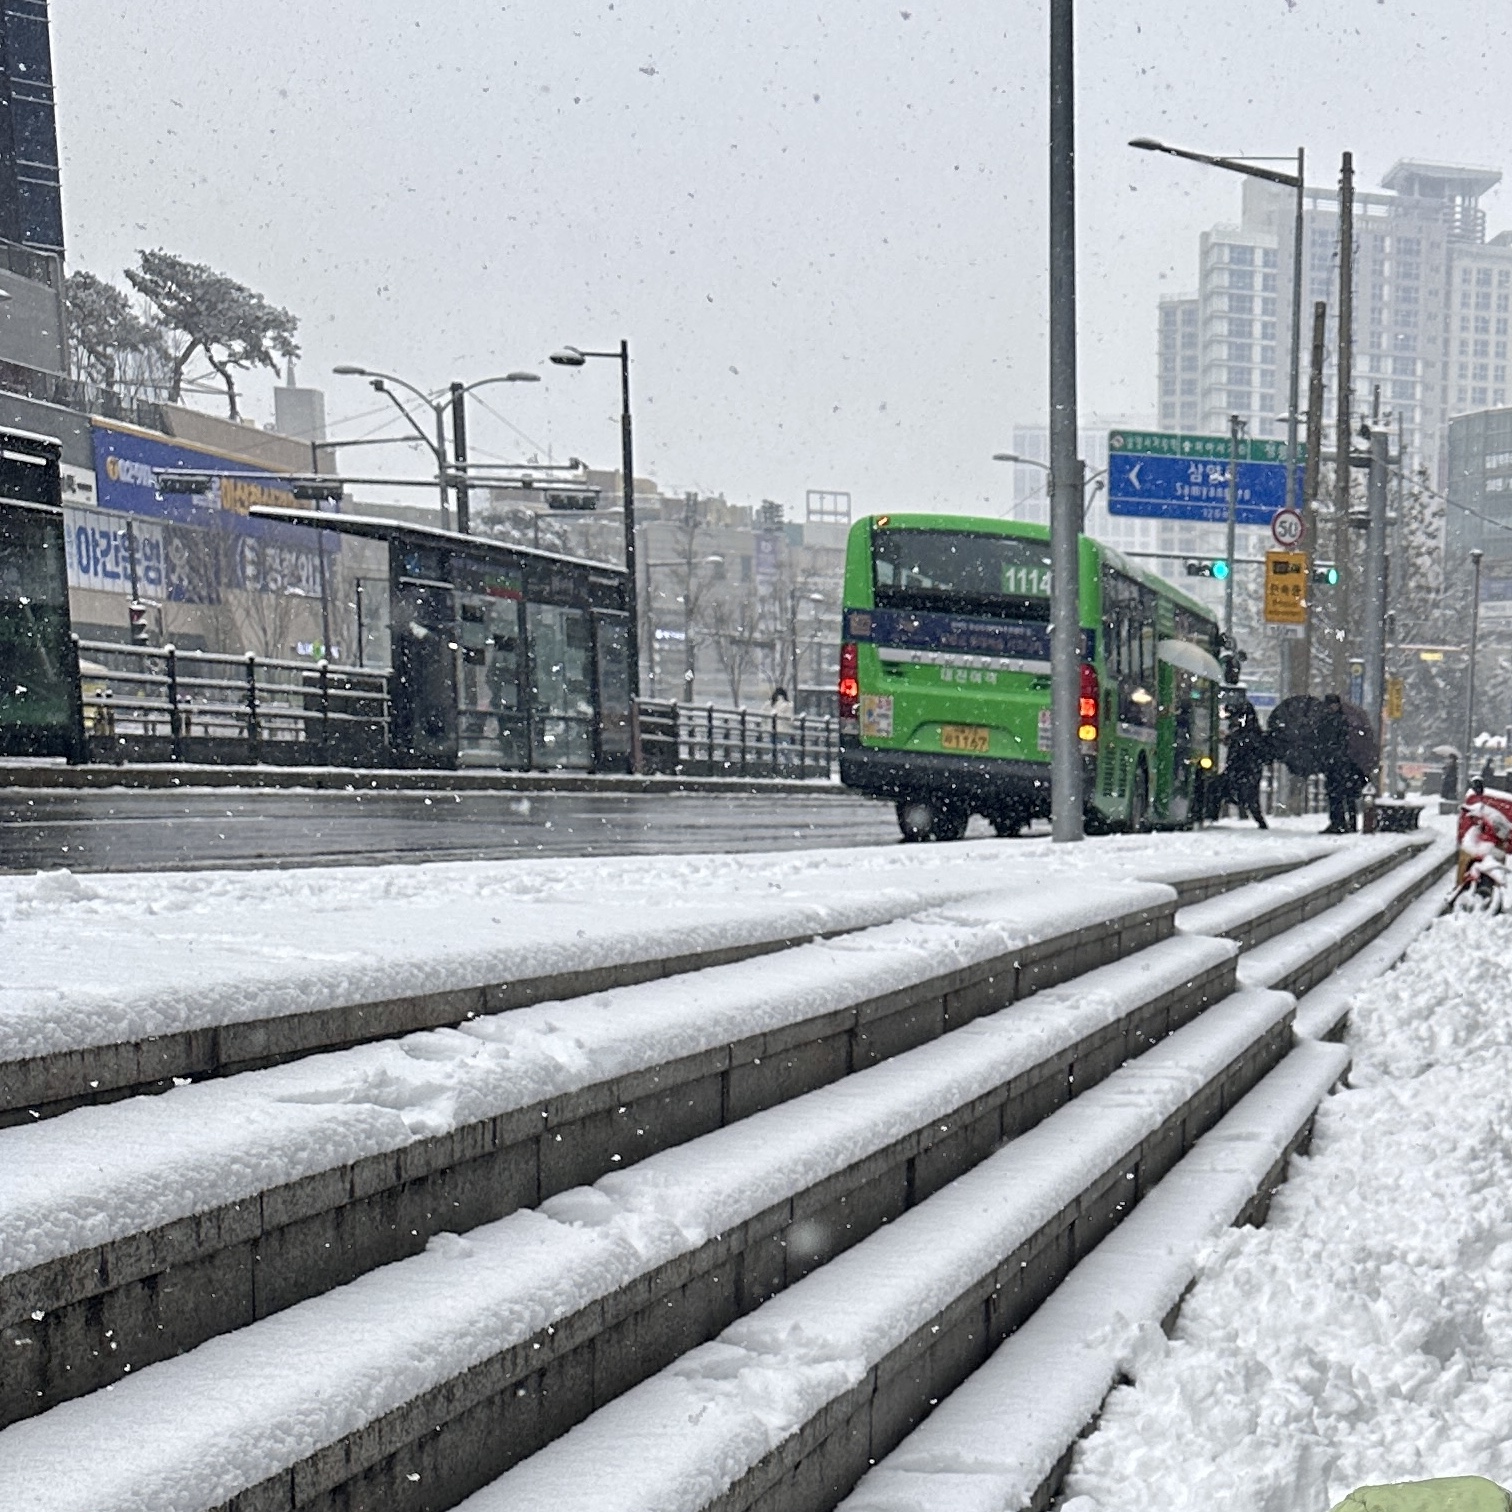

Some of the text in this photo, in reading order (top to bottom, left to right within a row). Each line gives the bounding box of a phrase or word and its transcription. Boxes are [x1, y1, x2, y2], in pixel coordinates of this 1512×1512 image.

[1278, 520, 1298, 539] 50
[76, 525, 162, 586] 야간운영
[1006, 566, 1052, 596] 1114
